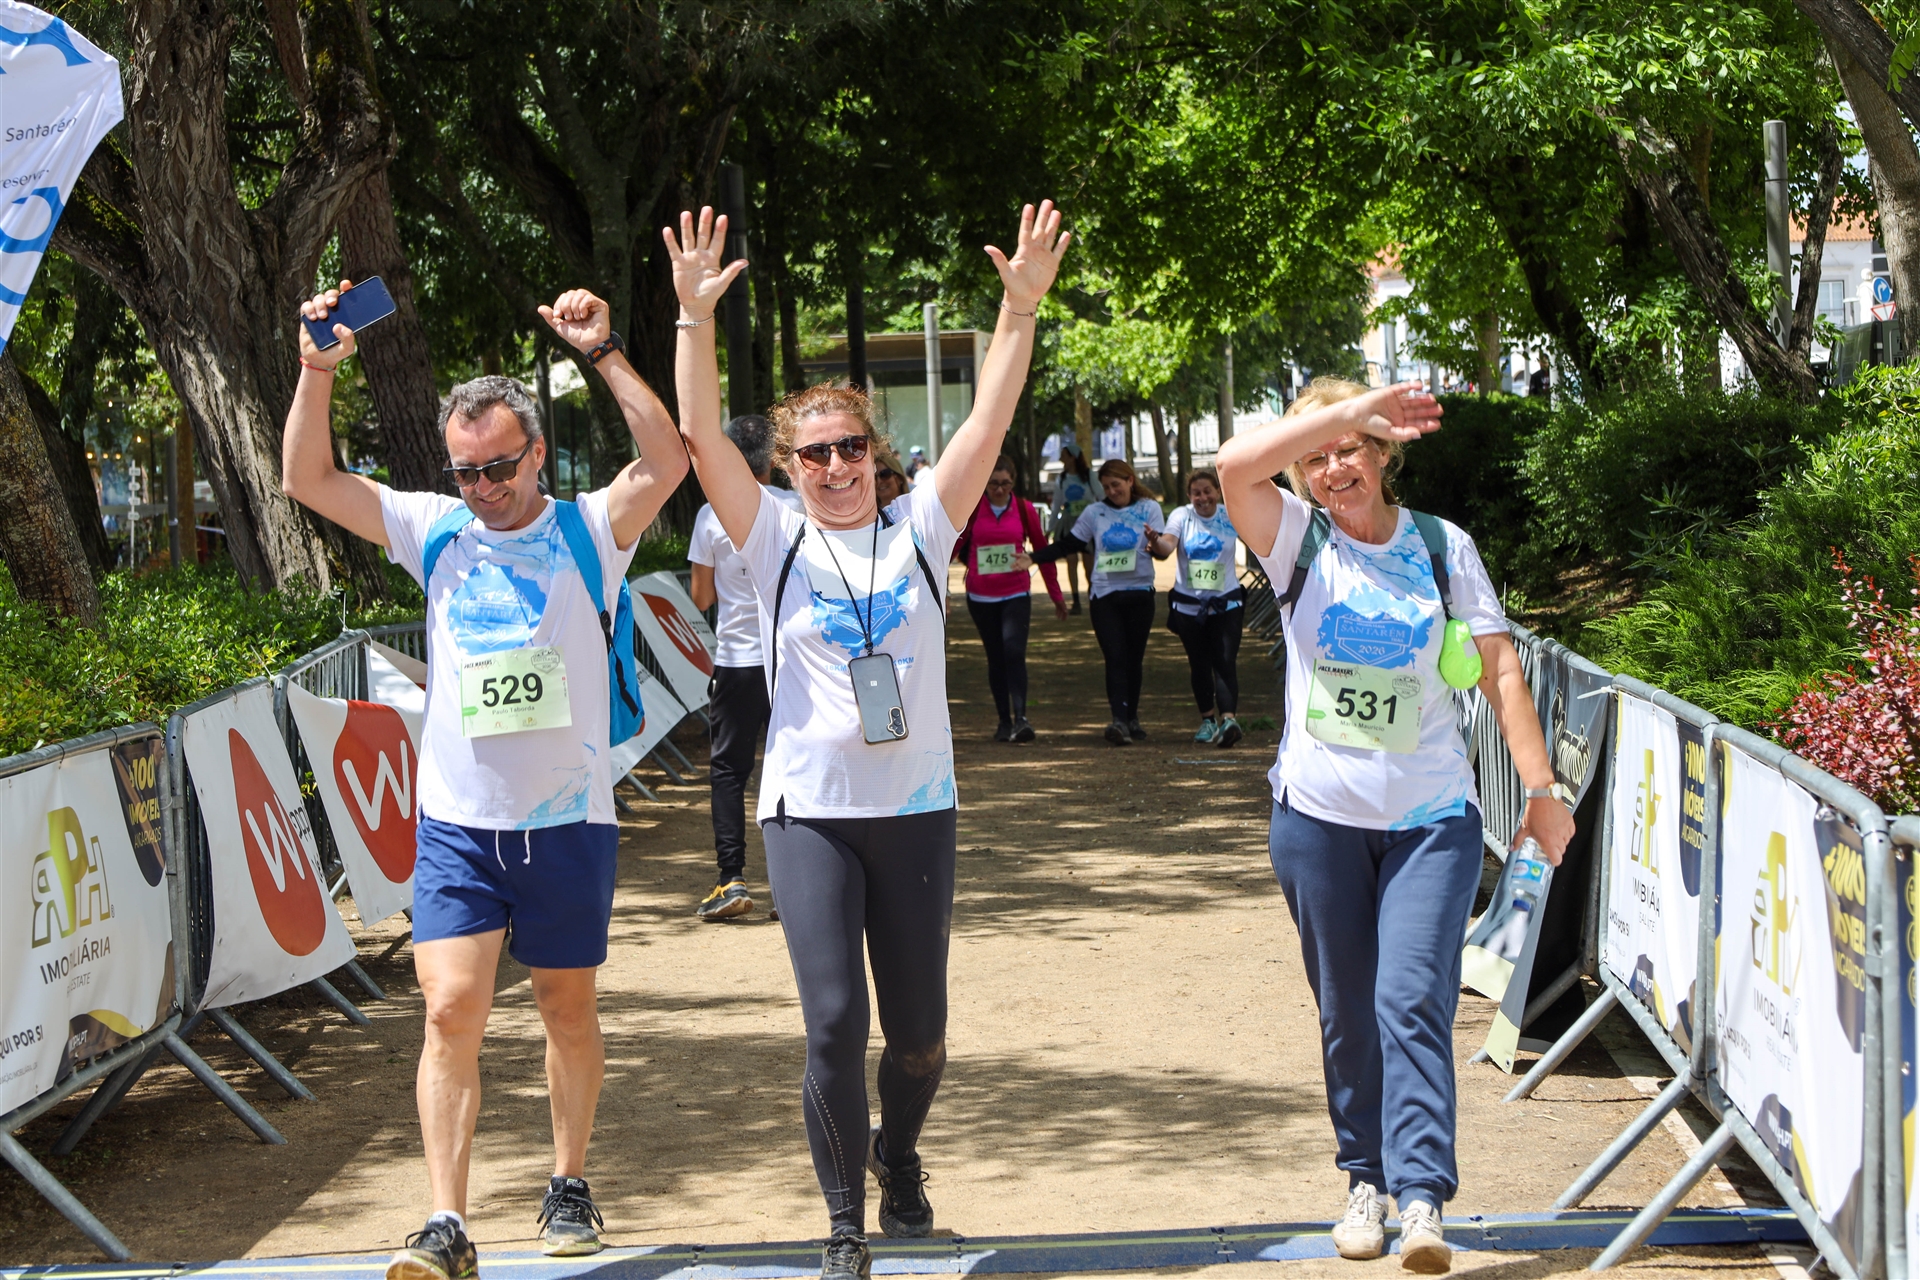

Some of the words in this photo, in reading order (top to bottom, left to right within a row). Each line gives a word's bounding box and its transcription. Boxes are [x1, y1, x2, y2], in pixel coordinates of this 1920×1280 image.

[986, 553, 1008, 565] 475
[1106, 557, 1128, 566] 476
[1195, 569, 1218, 581] 478
[1340, 623, 1406, 639] SANTARÉM
[1358, 644, 1386, 656] 2026
[482, 672, 543, 707] 529
[1335, 687, 1397, 725] 531
[342, 739, 411, 832] W
[245, 793, 306, 893] W
[12, 1028, 36, 1050] POR
[35, 1024, 44, 1041] SI
